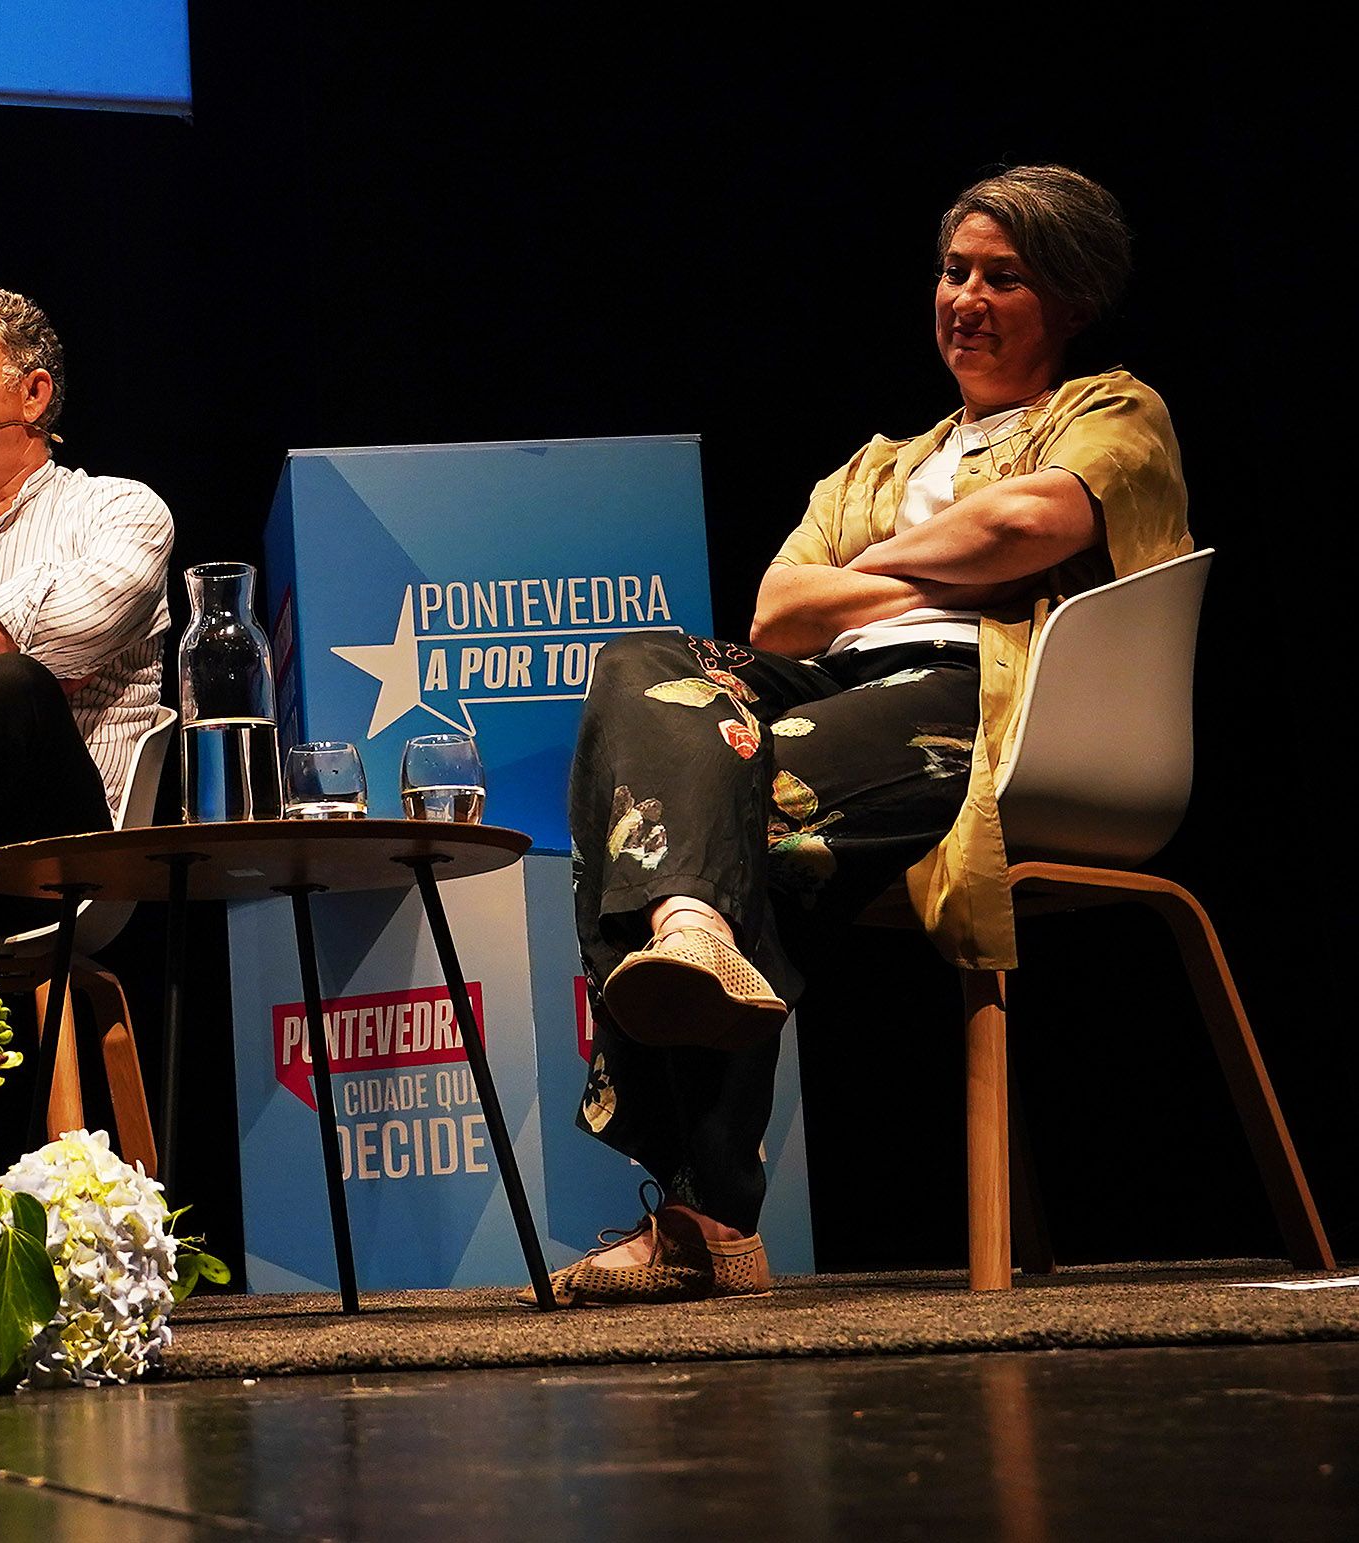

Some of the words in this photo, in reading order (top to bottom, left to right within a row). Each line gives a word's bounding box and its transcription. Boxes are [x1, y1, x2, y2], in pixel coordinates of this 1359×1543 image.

[420, 574, 672, 630] PONTEVEDRA
[423, 648, 449, 692] A
[459, 645, 533, 690] POR
[344, 1073, 429, 1117] CIDADE
